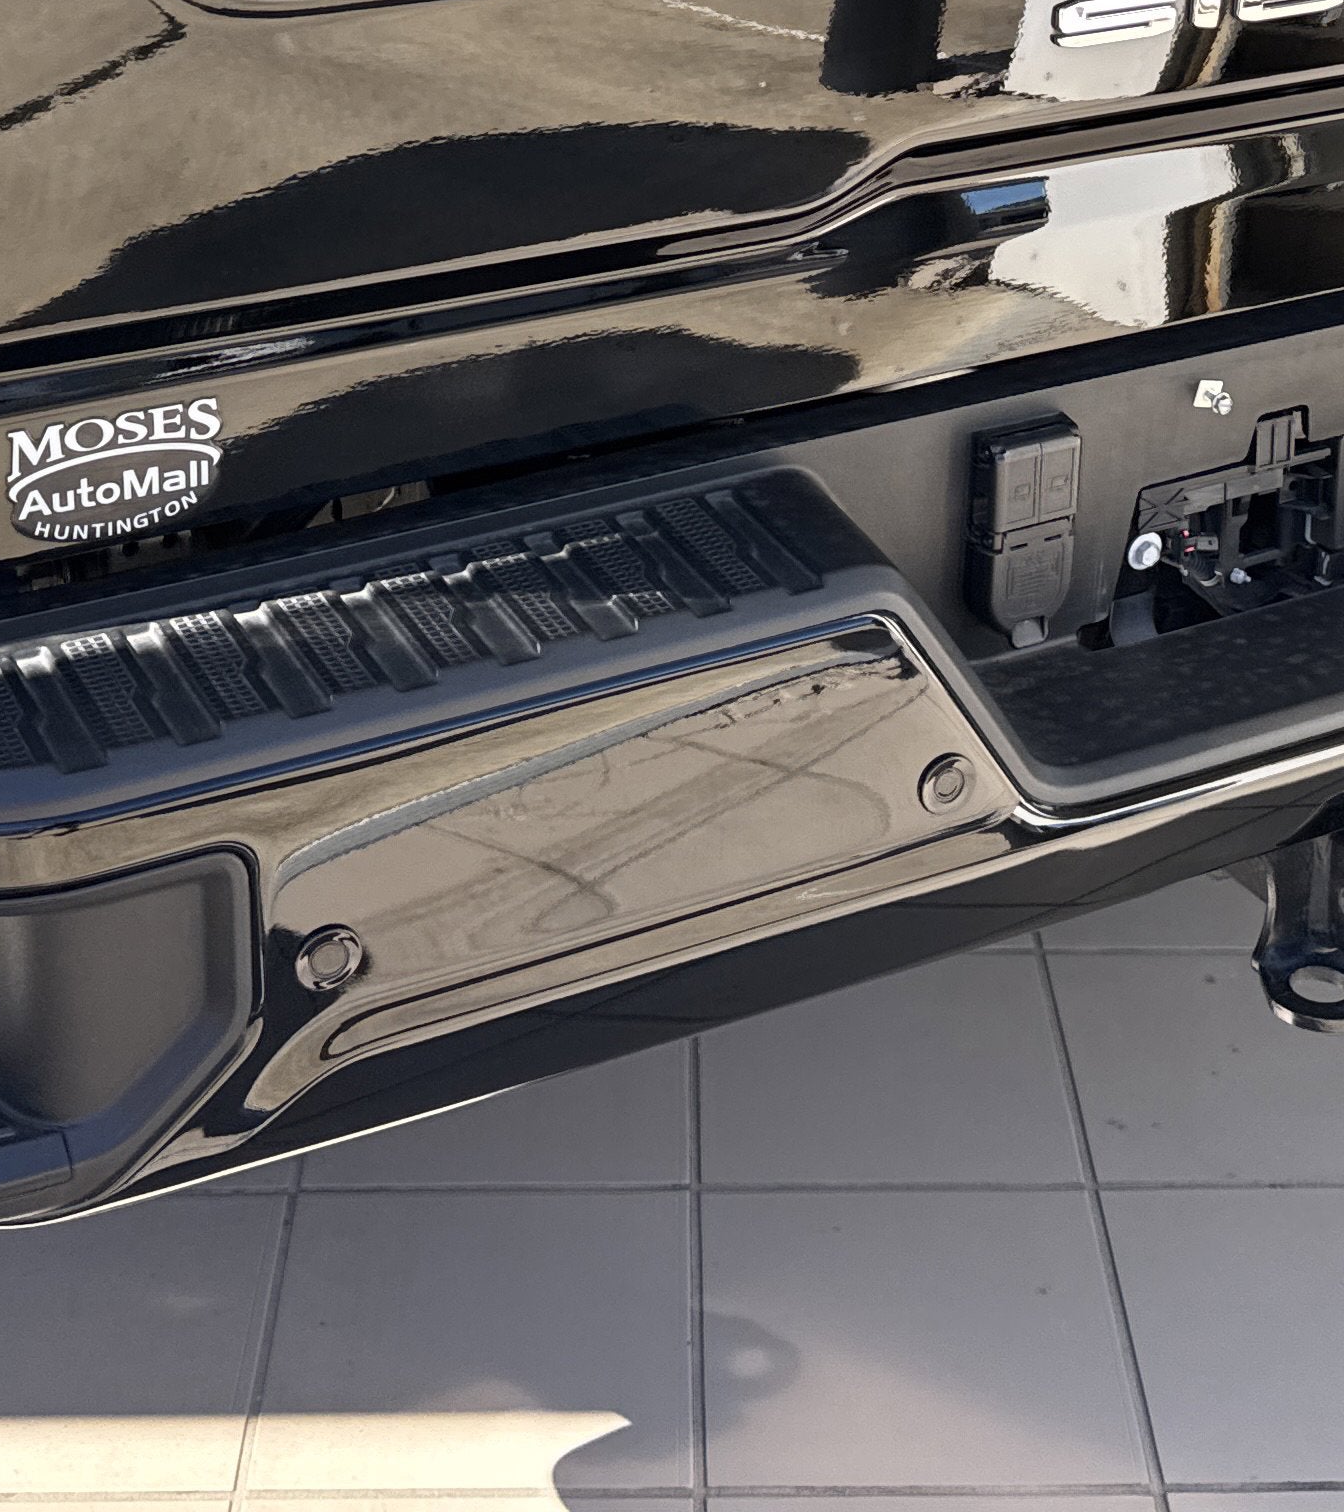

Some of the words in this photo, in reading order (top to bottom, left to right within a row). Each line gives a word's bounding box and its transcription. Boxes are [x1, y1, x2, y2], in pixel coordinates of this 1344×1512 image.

[7, 398, 222, 482] MOSES
[18, 460, 209, 521] AutoMall
[34, 490, 198, 540] HUNTINGTON
